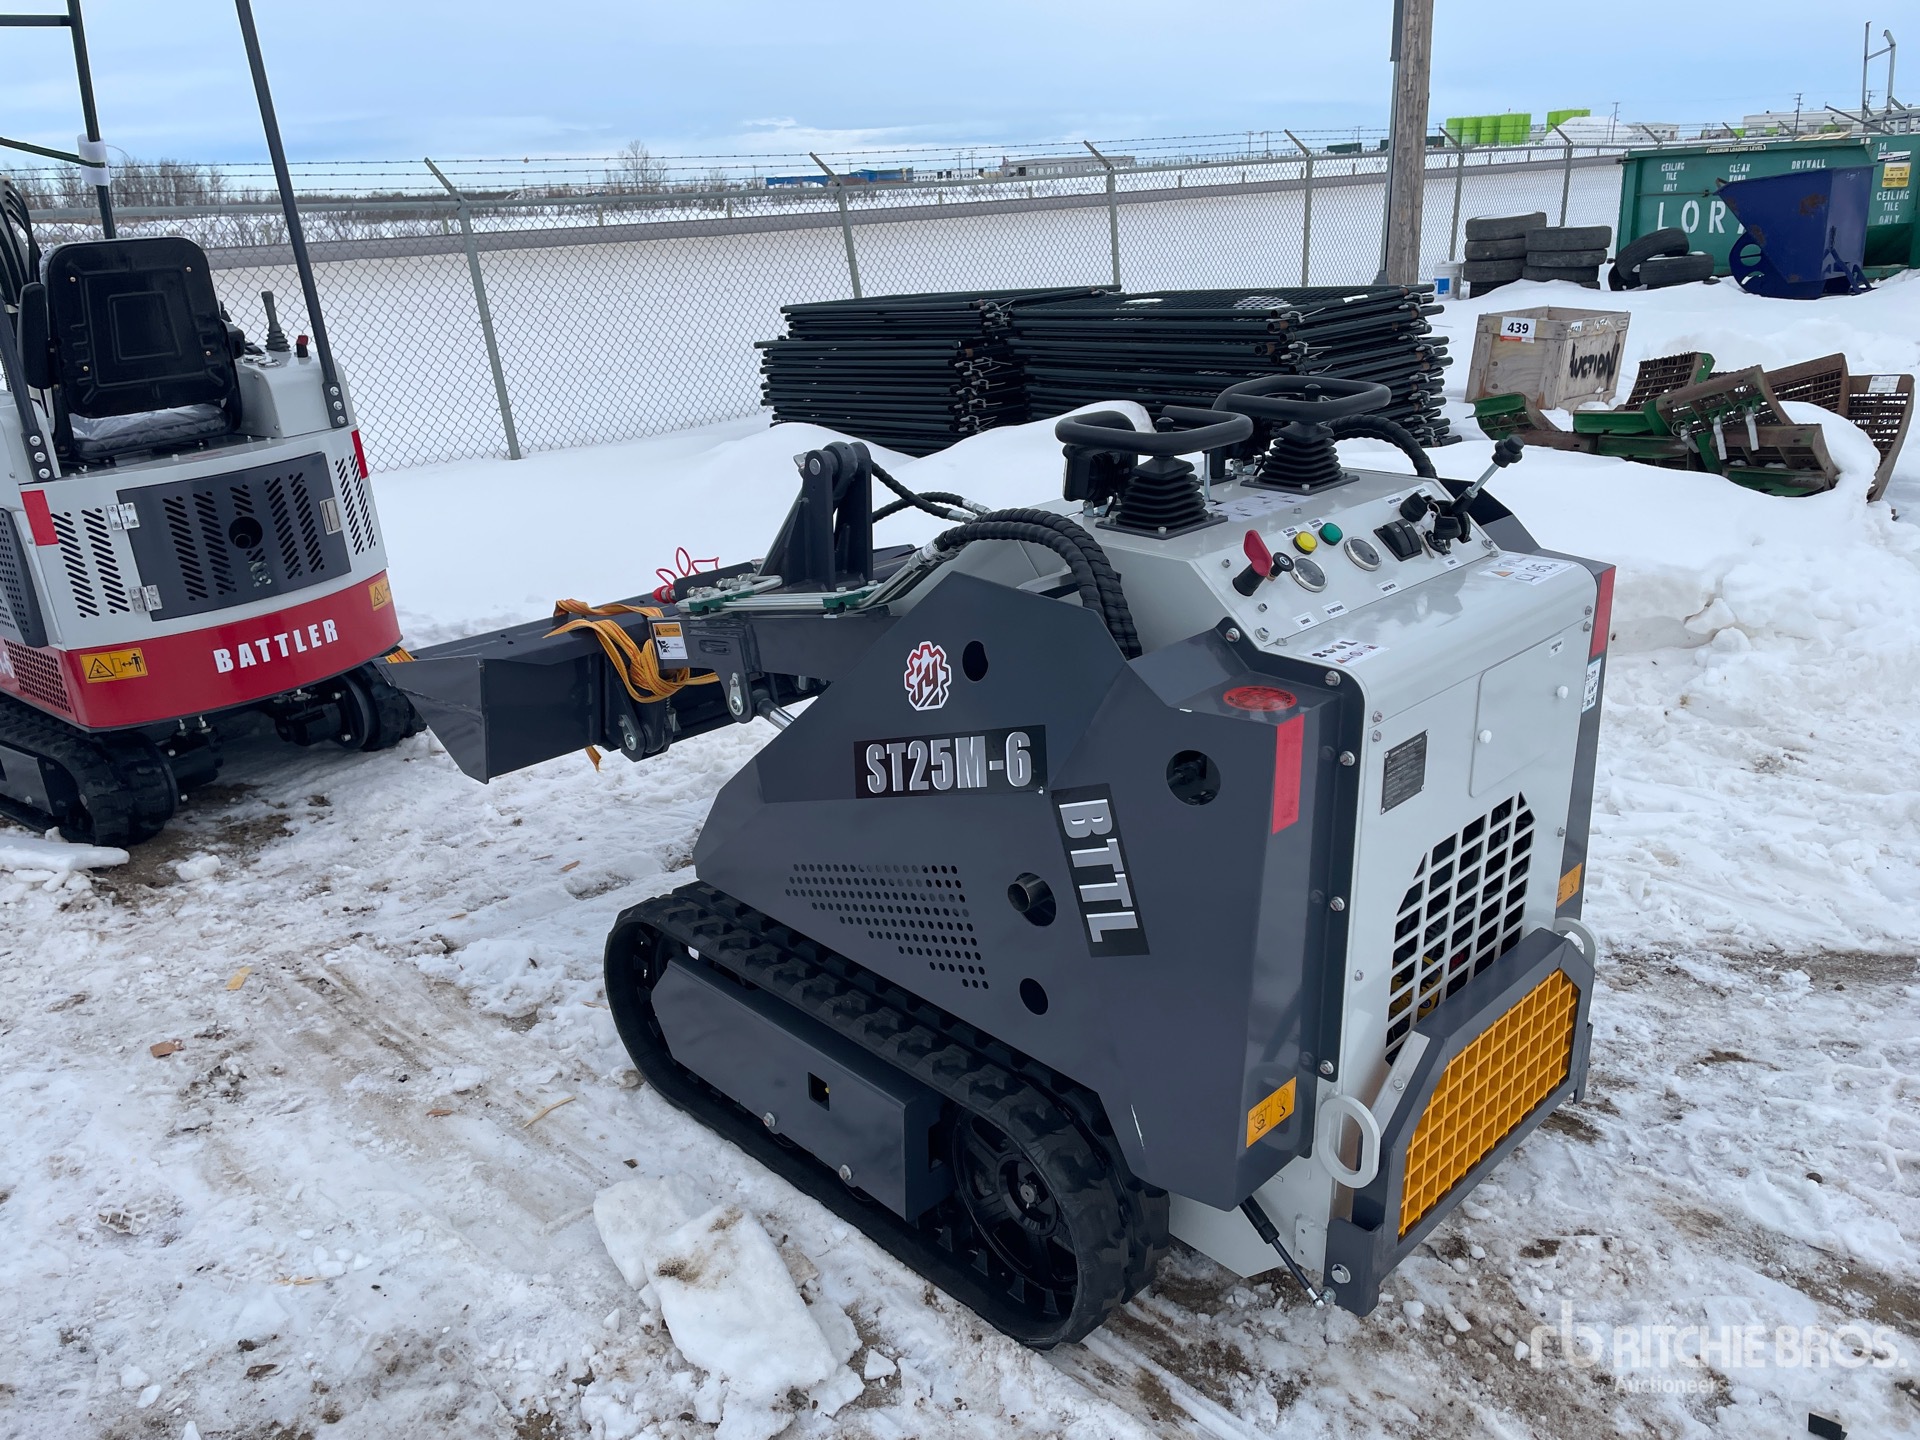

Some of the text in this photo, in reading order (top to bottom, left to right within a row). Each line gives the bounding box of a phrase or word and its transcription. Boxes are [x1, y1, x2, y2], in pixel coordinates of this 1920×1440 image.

[1879, 142, 1887, 152] 14
[1660, 162, 1685, 172] CEILING
[1791, 158, 1827, 170] DRYWALL
[1666, 172, 1678, 181] TILE
[1663, 183, 1678, 192] ONLY
[1876, 190, 1910, 201] CEILING
[1883, 202, 1899, 212] TILE
[1507, 322, 1529, 334] 439
[212, 618, 339, 675] BATTLER
[865, 731, 1032, 794] ST25M-6
[1058, 798, 1139, 943] BTTL
